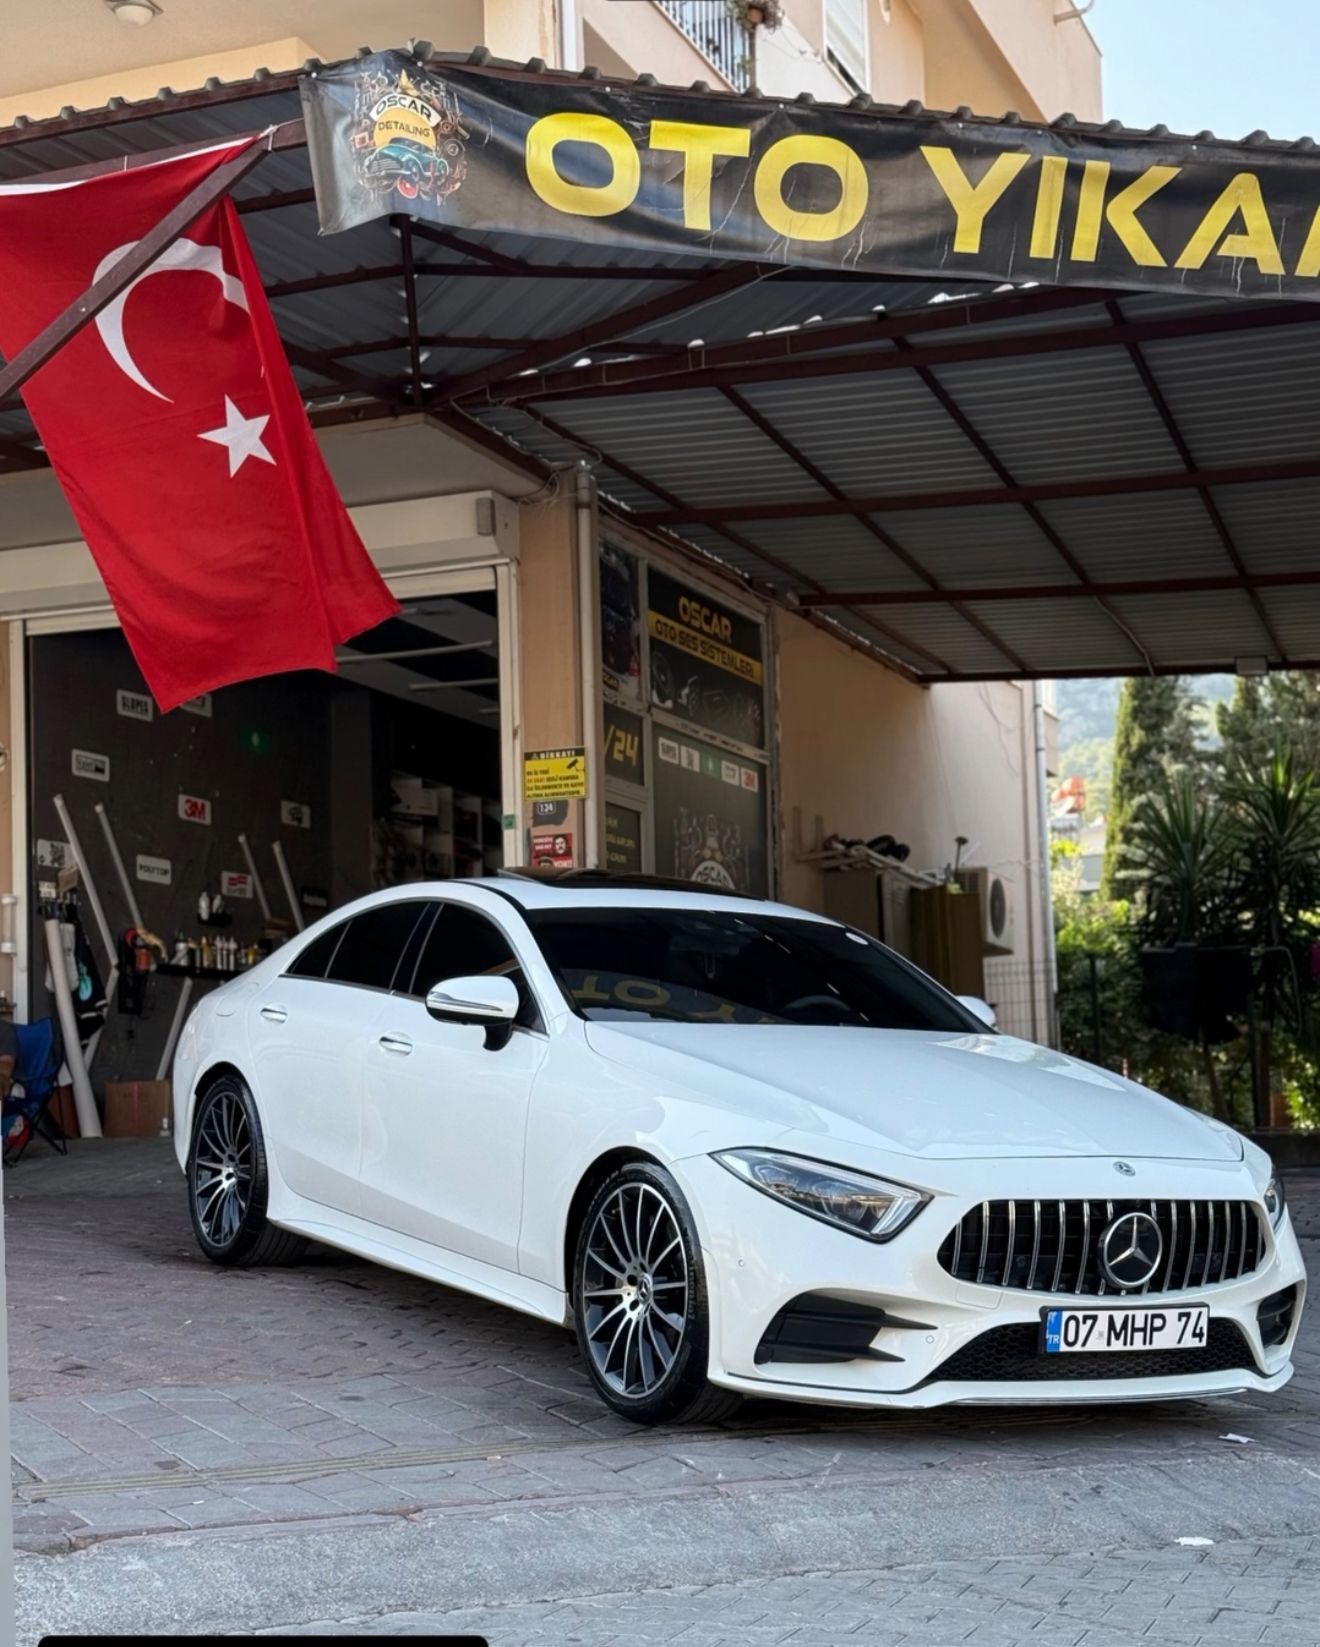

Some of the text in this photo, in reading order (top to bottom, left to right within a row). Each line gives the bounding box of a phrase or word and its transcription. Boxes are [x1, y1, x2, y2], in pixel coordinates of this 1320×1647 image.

[375, 94, 433, 122] OSCAR
[378, 120, 430, 138] DETAILING
[524, 112, 869, 242] OTO
[655, 619, 677, 641] OTO
[678, 596, 732, 644] OSCAR
[184, 798, 206, 820] 3M
[1047, 1334, 1060, 1345] TR
[1063, 1311, 1205, 1347] 07 MHP 74
